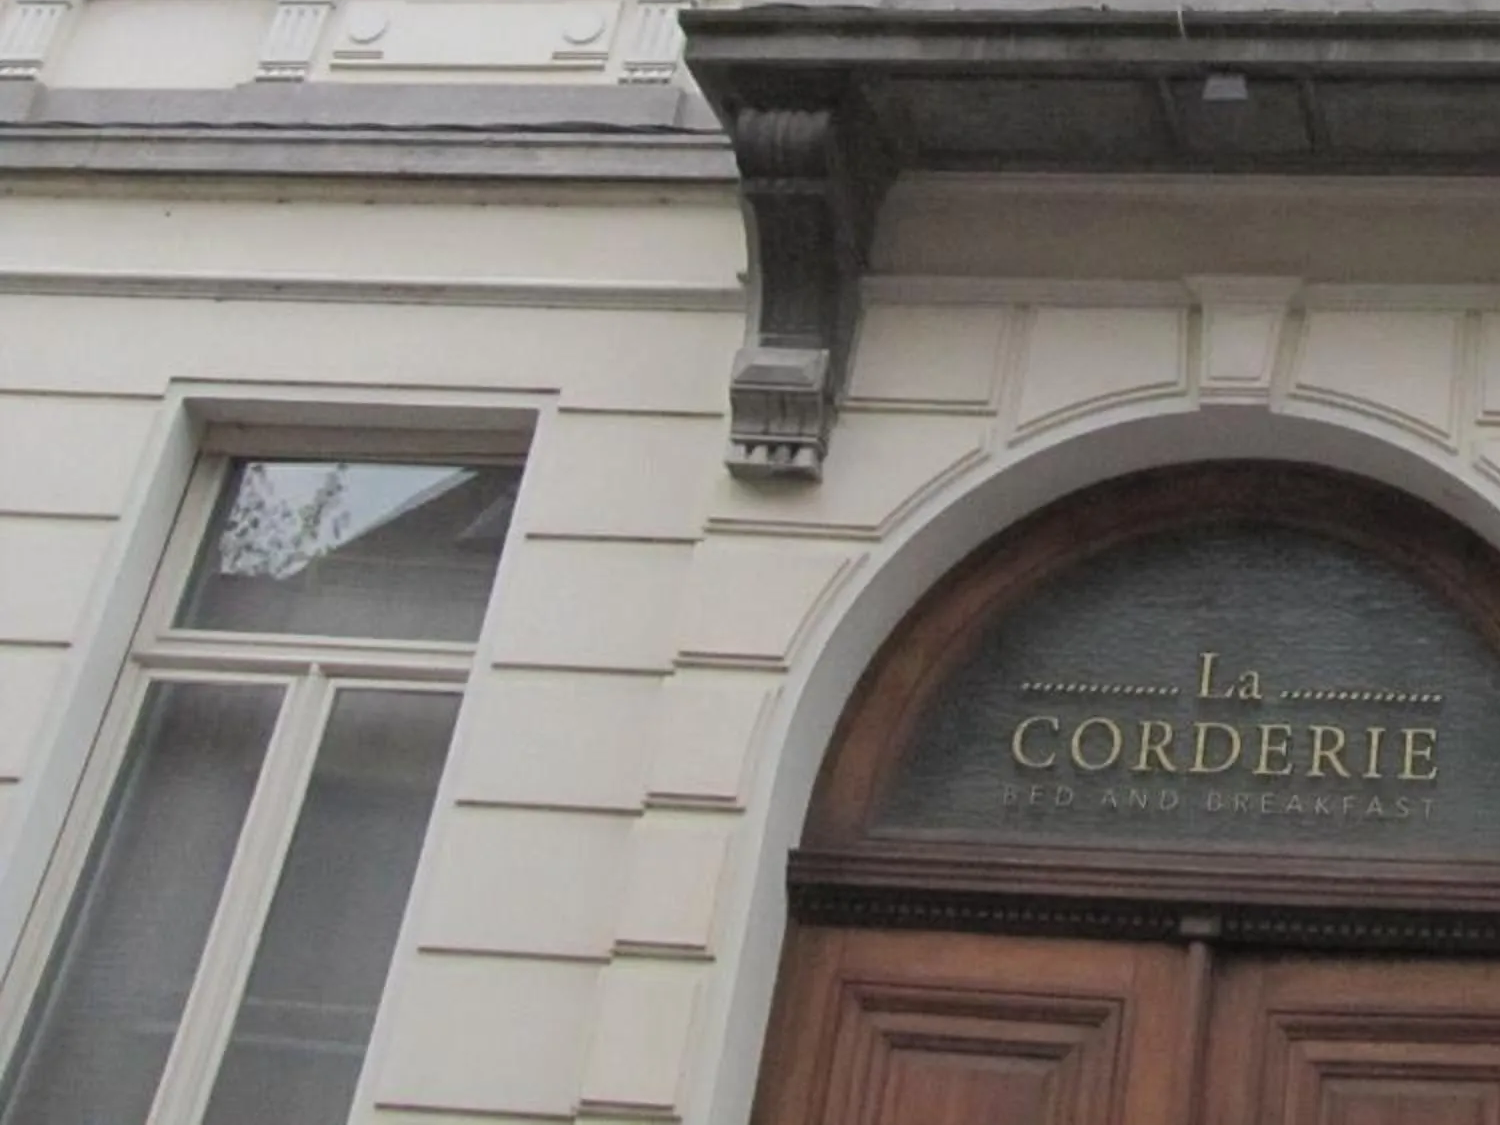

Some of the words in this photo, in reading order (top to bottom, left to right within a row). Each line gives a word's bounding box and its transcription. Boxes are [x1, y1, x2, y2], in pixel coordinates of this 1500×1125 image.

[1197, 651, 1262, 700] La
[1010, 716, 1439, 780] CORDERIE
[1003, 785, 1074, 808] BED
[1101, 787, 1180, 811] AND
[1206, 790, 1438, 818] BREAKFAST
